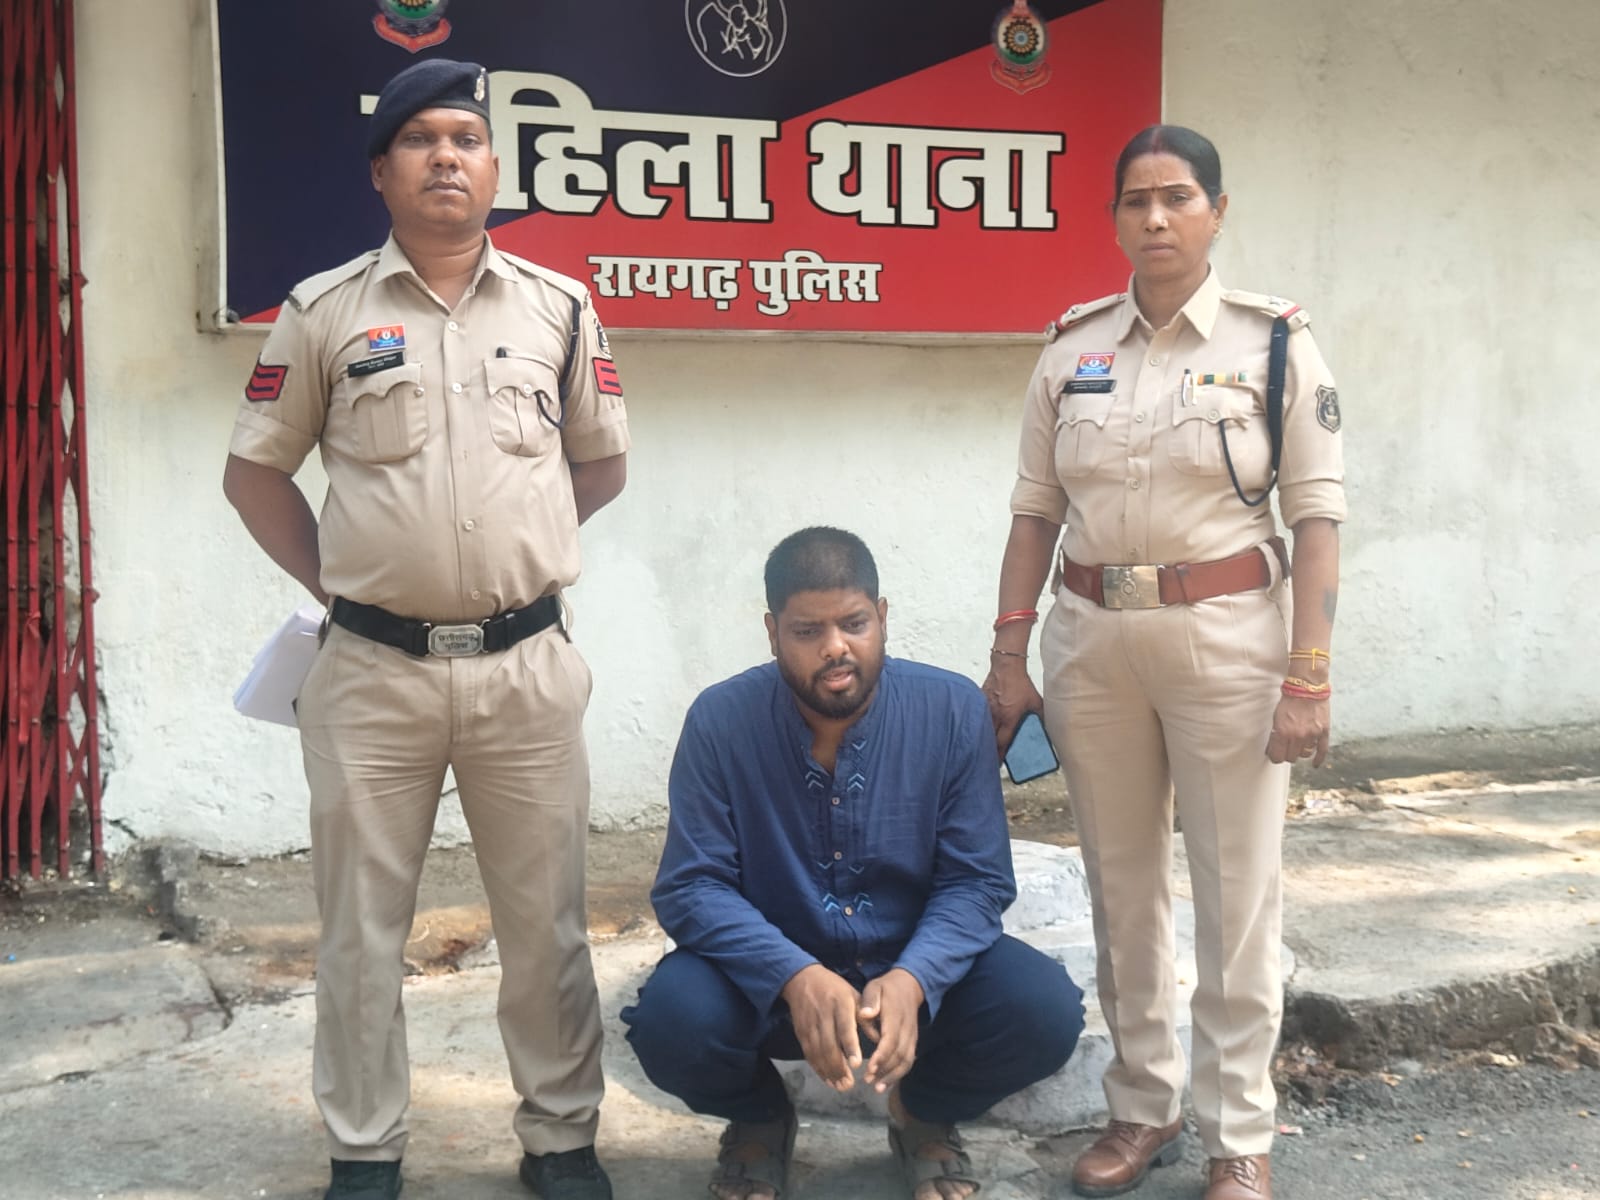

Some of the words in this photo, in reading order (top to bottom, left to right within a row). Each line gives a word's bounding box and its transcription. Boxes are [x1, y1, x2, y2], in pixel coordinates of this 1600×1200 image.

[360, 70, 778, 221] हिला
[809, 121, 1063, 228] थाना
[587, 255, 742, 310] रायगढ़
[748, 249, 883, 316] पुलिस
